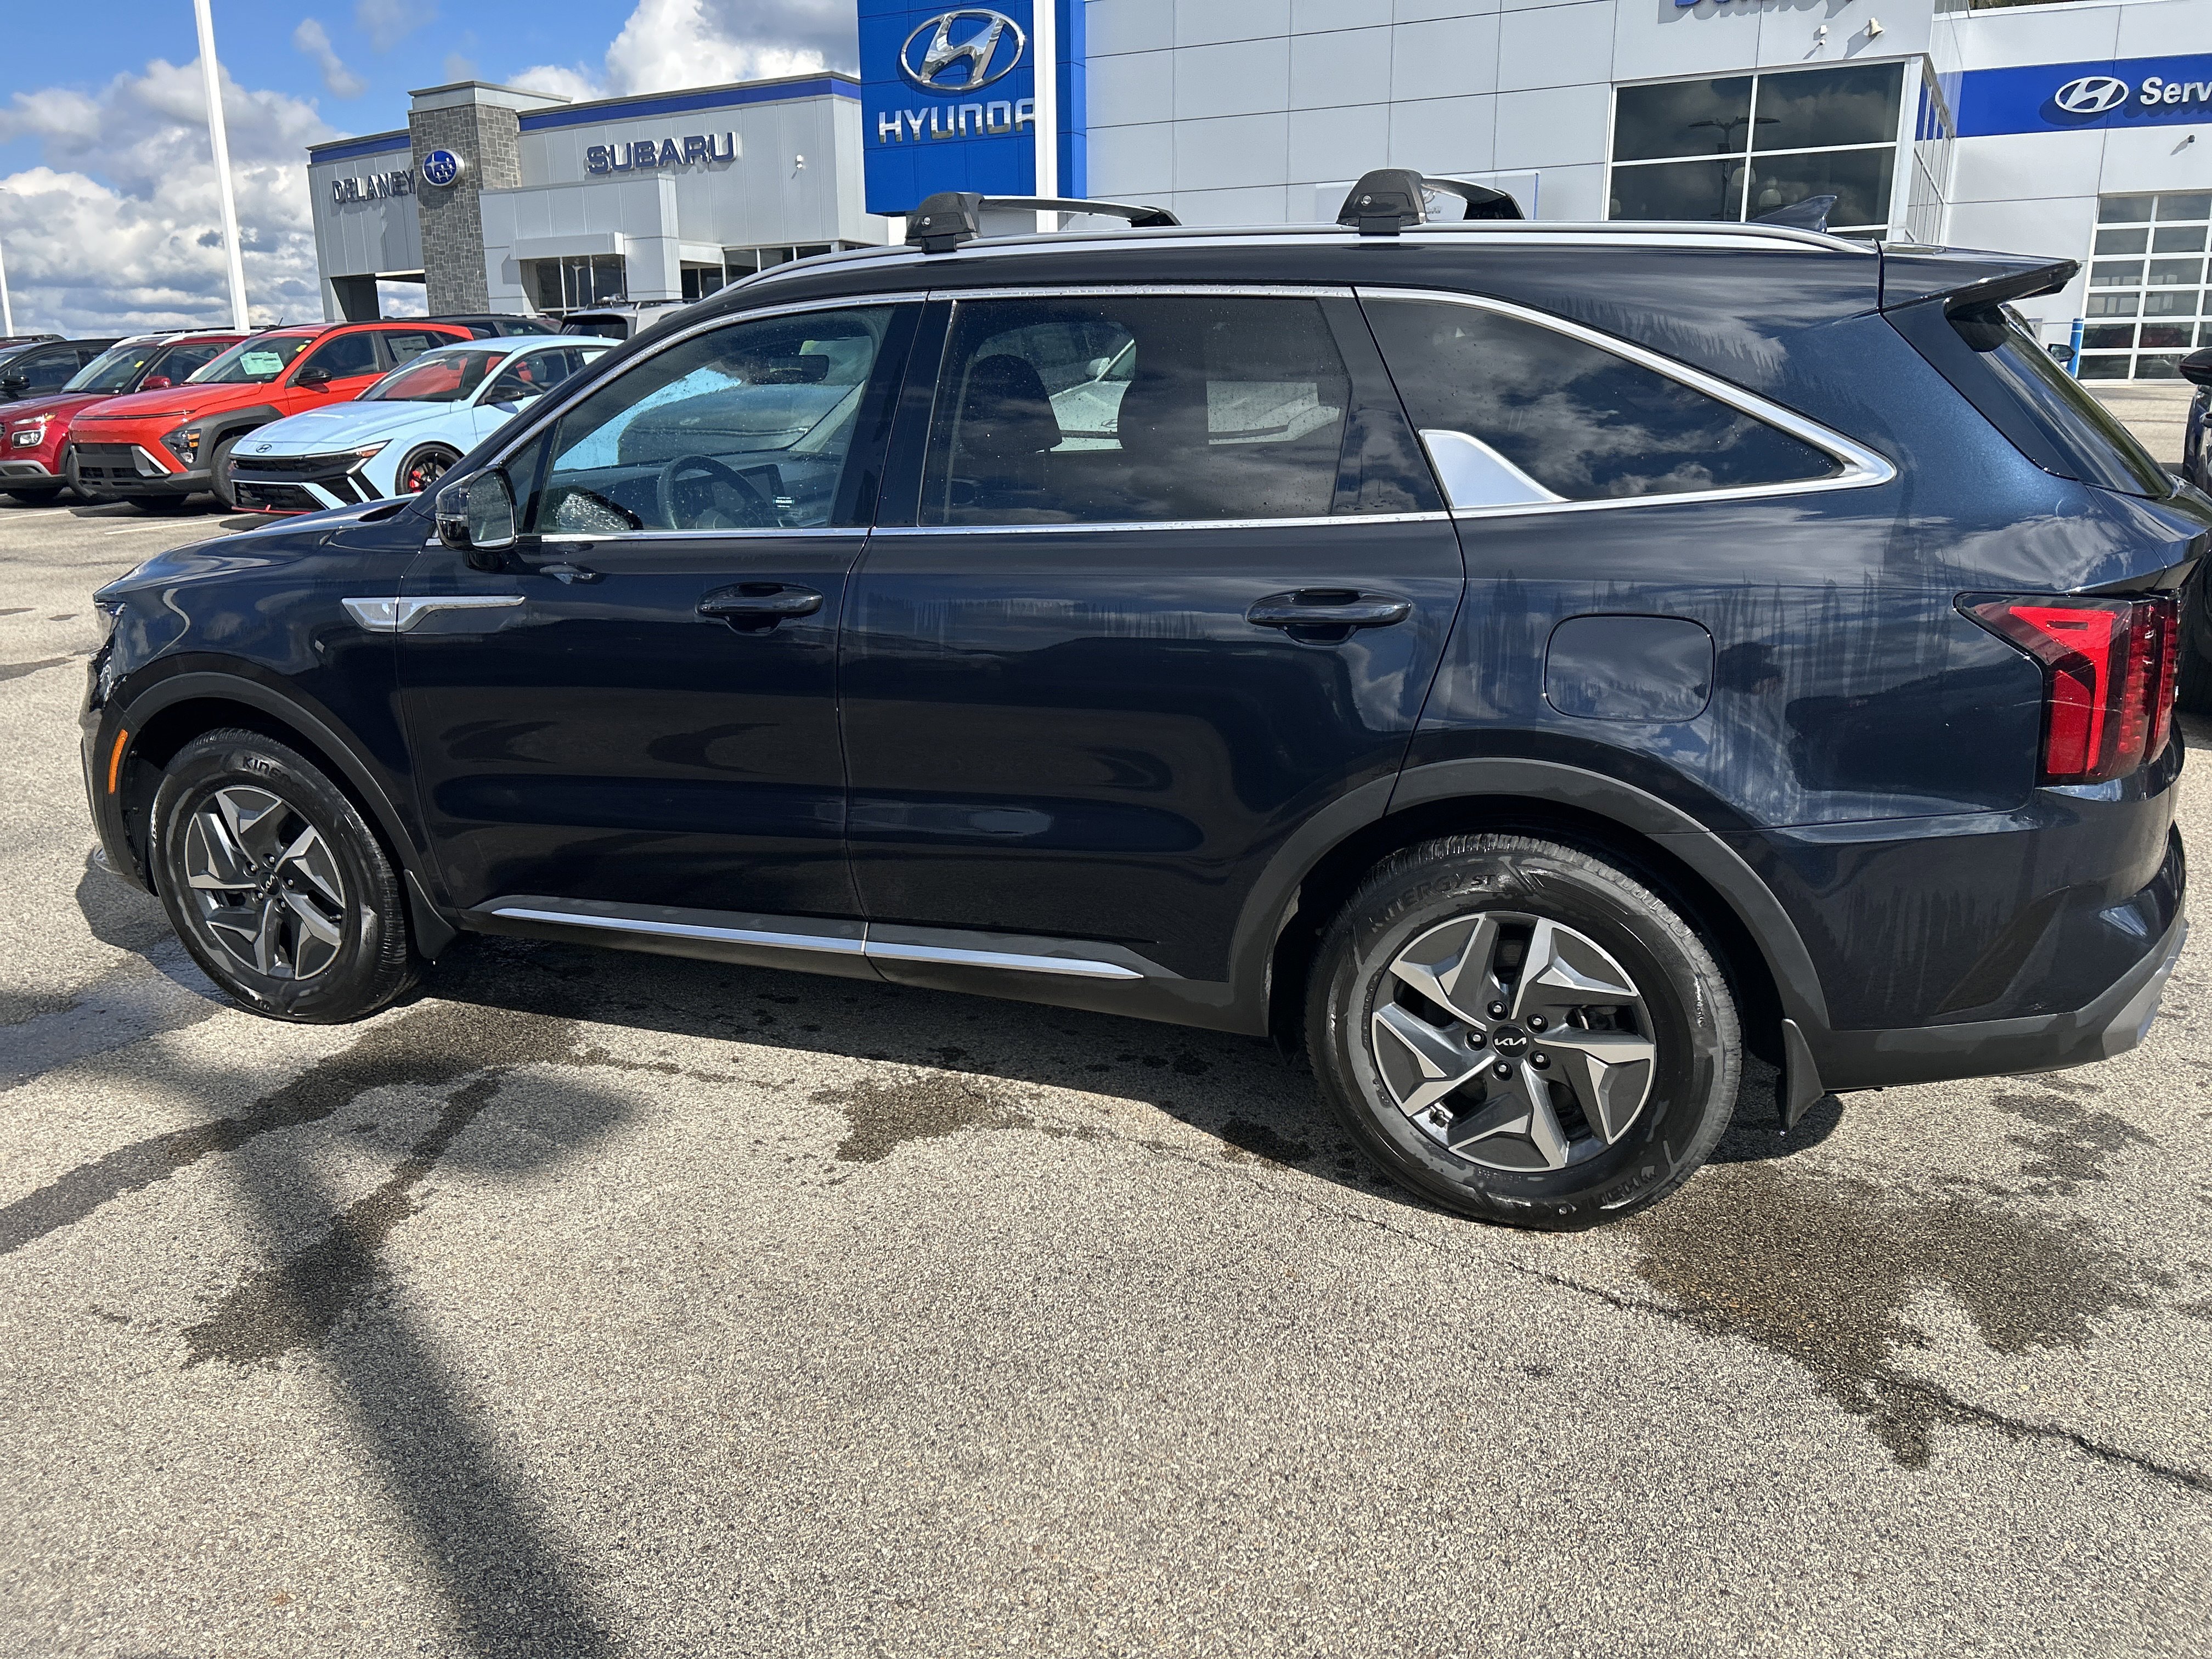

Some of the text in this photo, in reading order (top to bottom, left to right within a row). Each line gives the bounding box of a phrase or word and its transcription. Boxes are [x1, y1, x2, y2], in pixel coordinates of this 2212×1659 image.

[2140, 76, 2212, 105] Serv
[586, 132, 737, 174] SUBARU
[331, 169, 416, 204] DELANEY
[1471, 874, 1496, 886] ST
